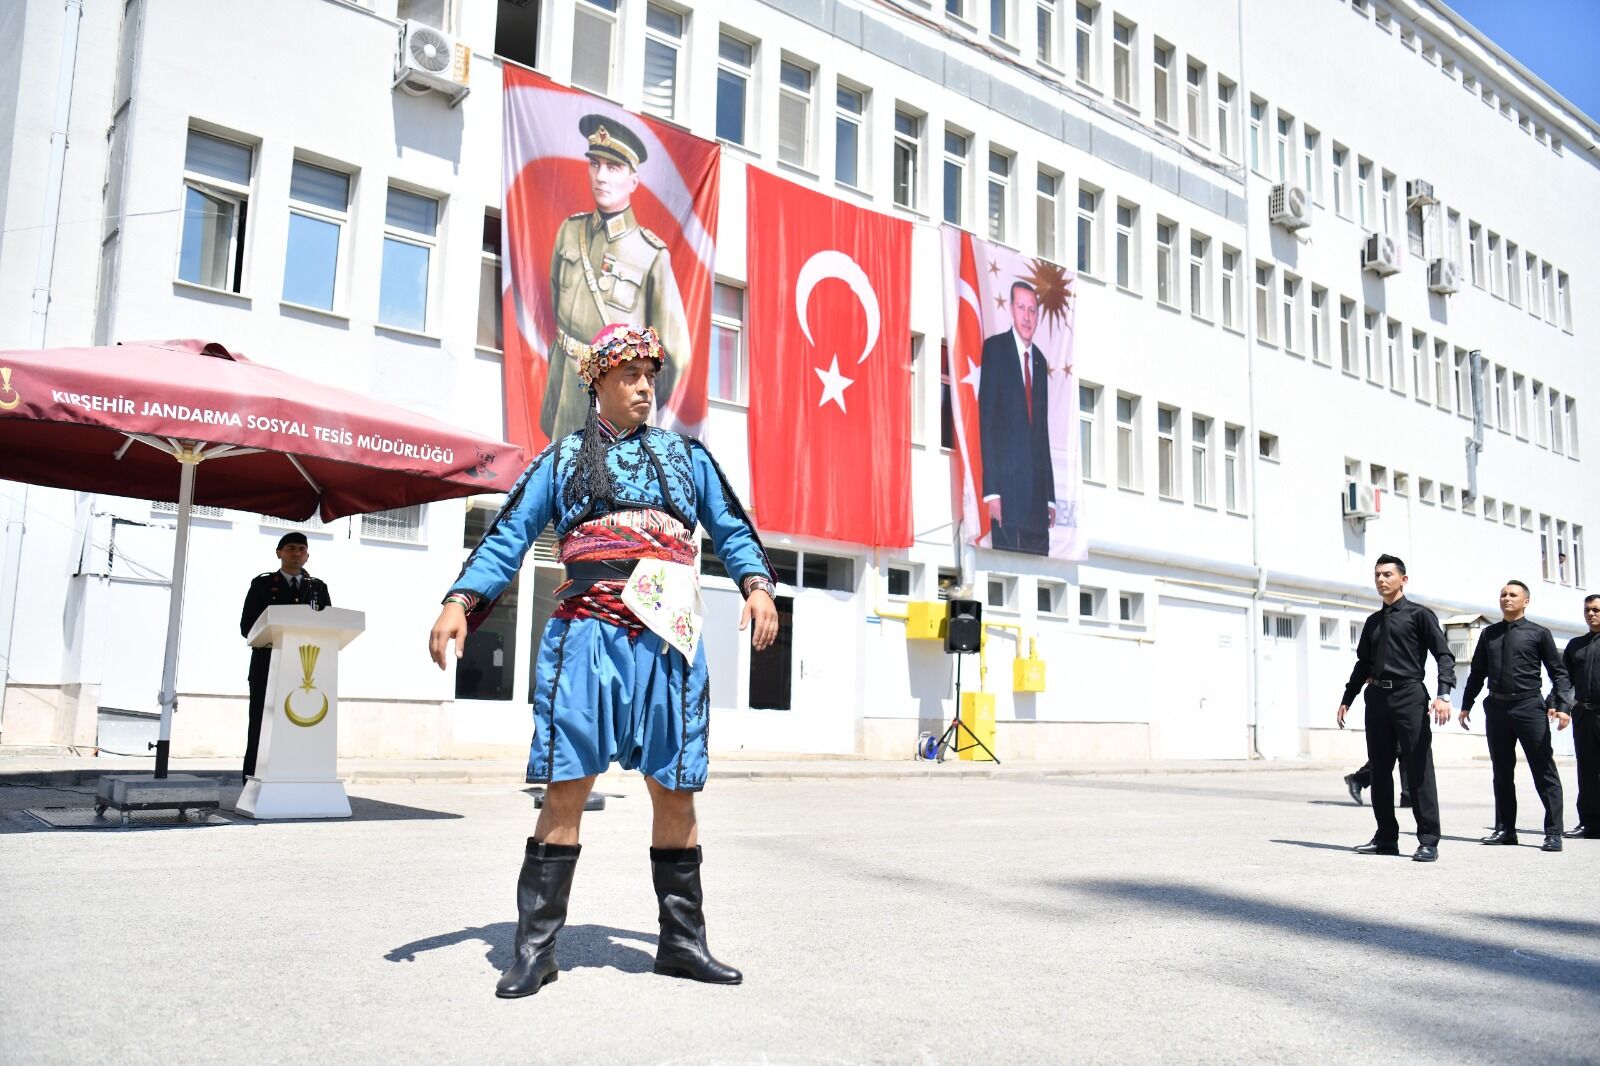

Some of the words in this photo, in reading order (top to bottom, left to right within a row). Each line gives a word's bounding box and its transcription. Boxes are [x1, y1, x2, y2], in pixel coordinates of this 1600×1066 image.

[52, 390, 135, 414] KIRŞEHİR
[140, 401, 242, 427] JANDARMA
[247, 414, 309, 438] SOSYAL
[313, 426, 353, 446] TESİS
[357, 433, 454, 465] MÜDÜRLÜĞÜ
